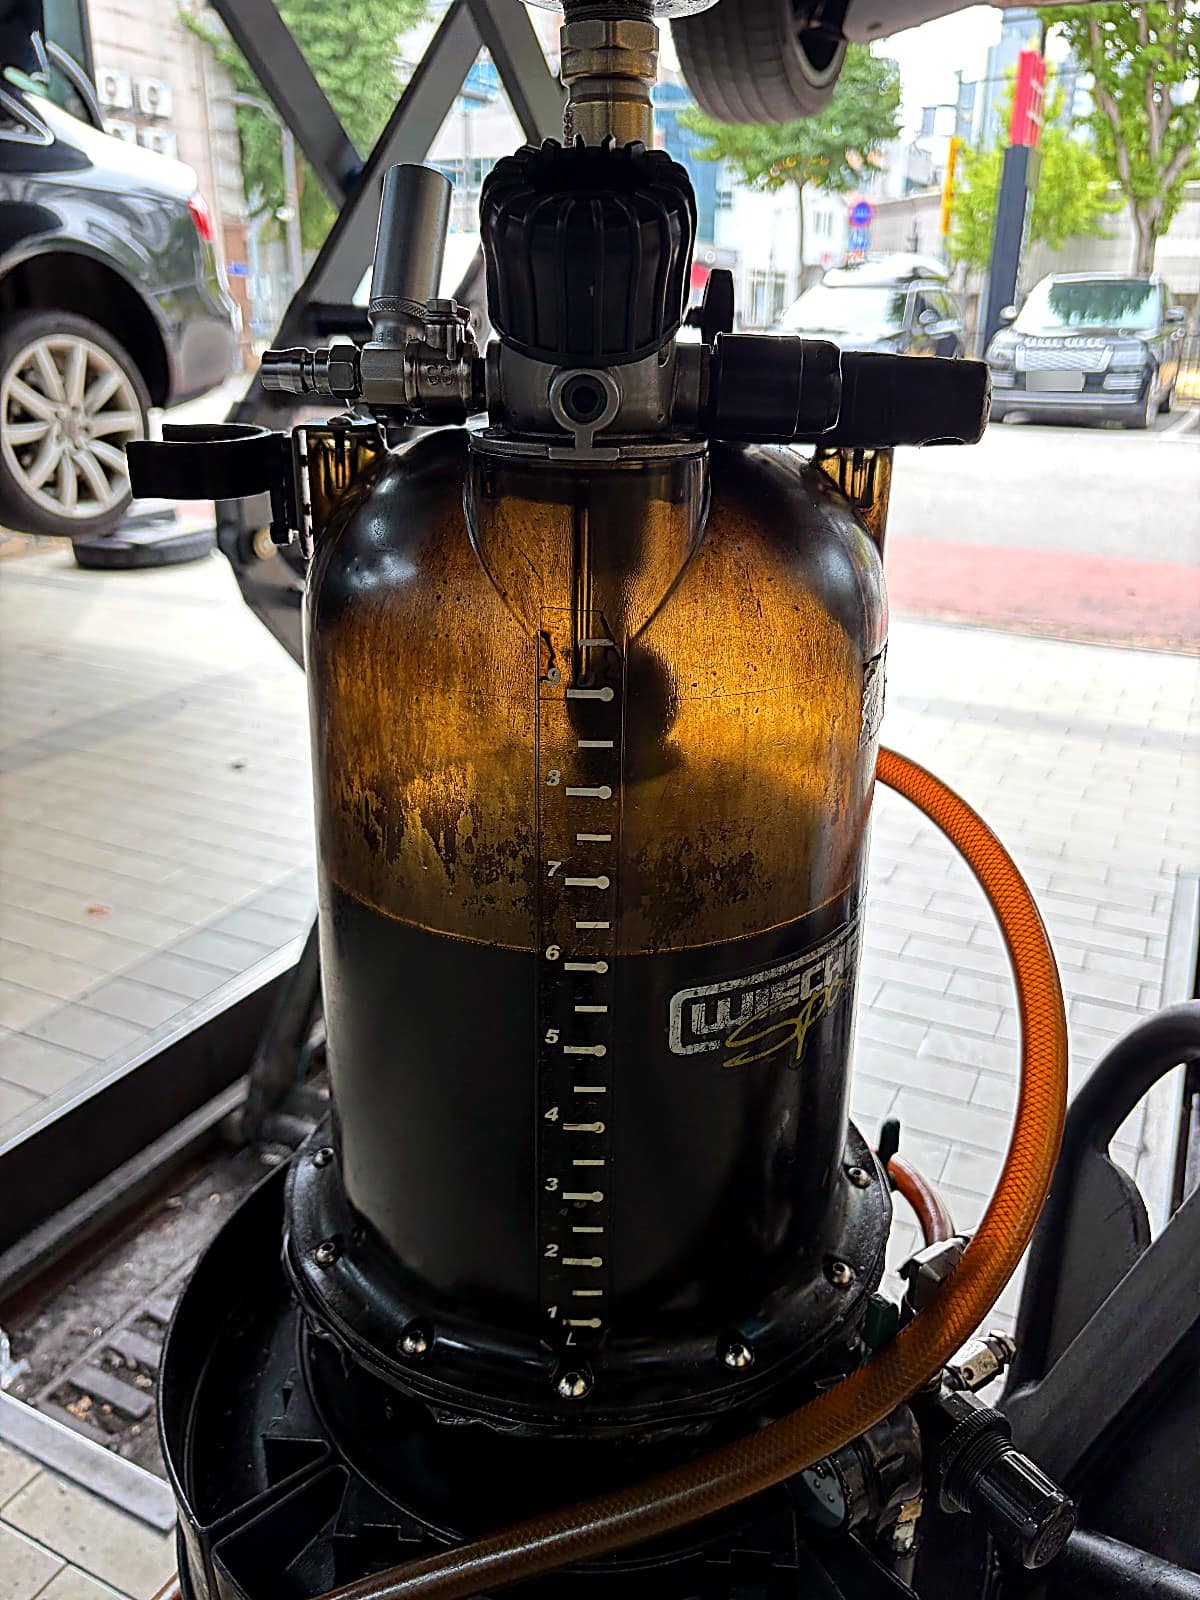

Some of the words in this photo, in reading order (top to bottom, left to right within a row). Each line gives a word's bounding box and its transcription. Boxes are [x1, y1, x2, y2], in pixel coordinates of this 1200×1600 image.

[545, 667, 560, 686] 9
[546, 769, 560, 787] 8
[547, 861, 562, 877] 7
[545, 944, 560, 961] 6
[544, 1028, 560, 1044] 5
[544, 1106, 559, 1121] 4
[544, 1177, 559, 1191] 3
[544, 1243, 559, 1257] 2
[547, 1305, 558, 1319] 1
[565, 1331, 577, 1346] L
